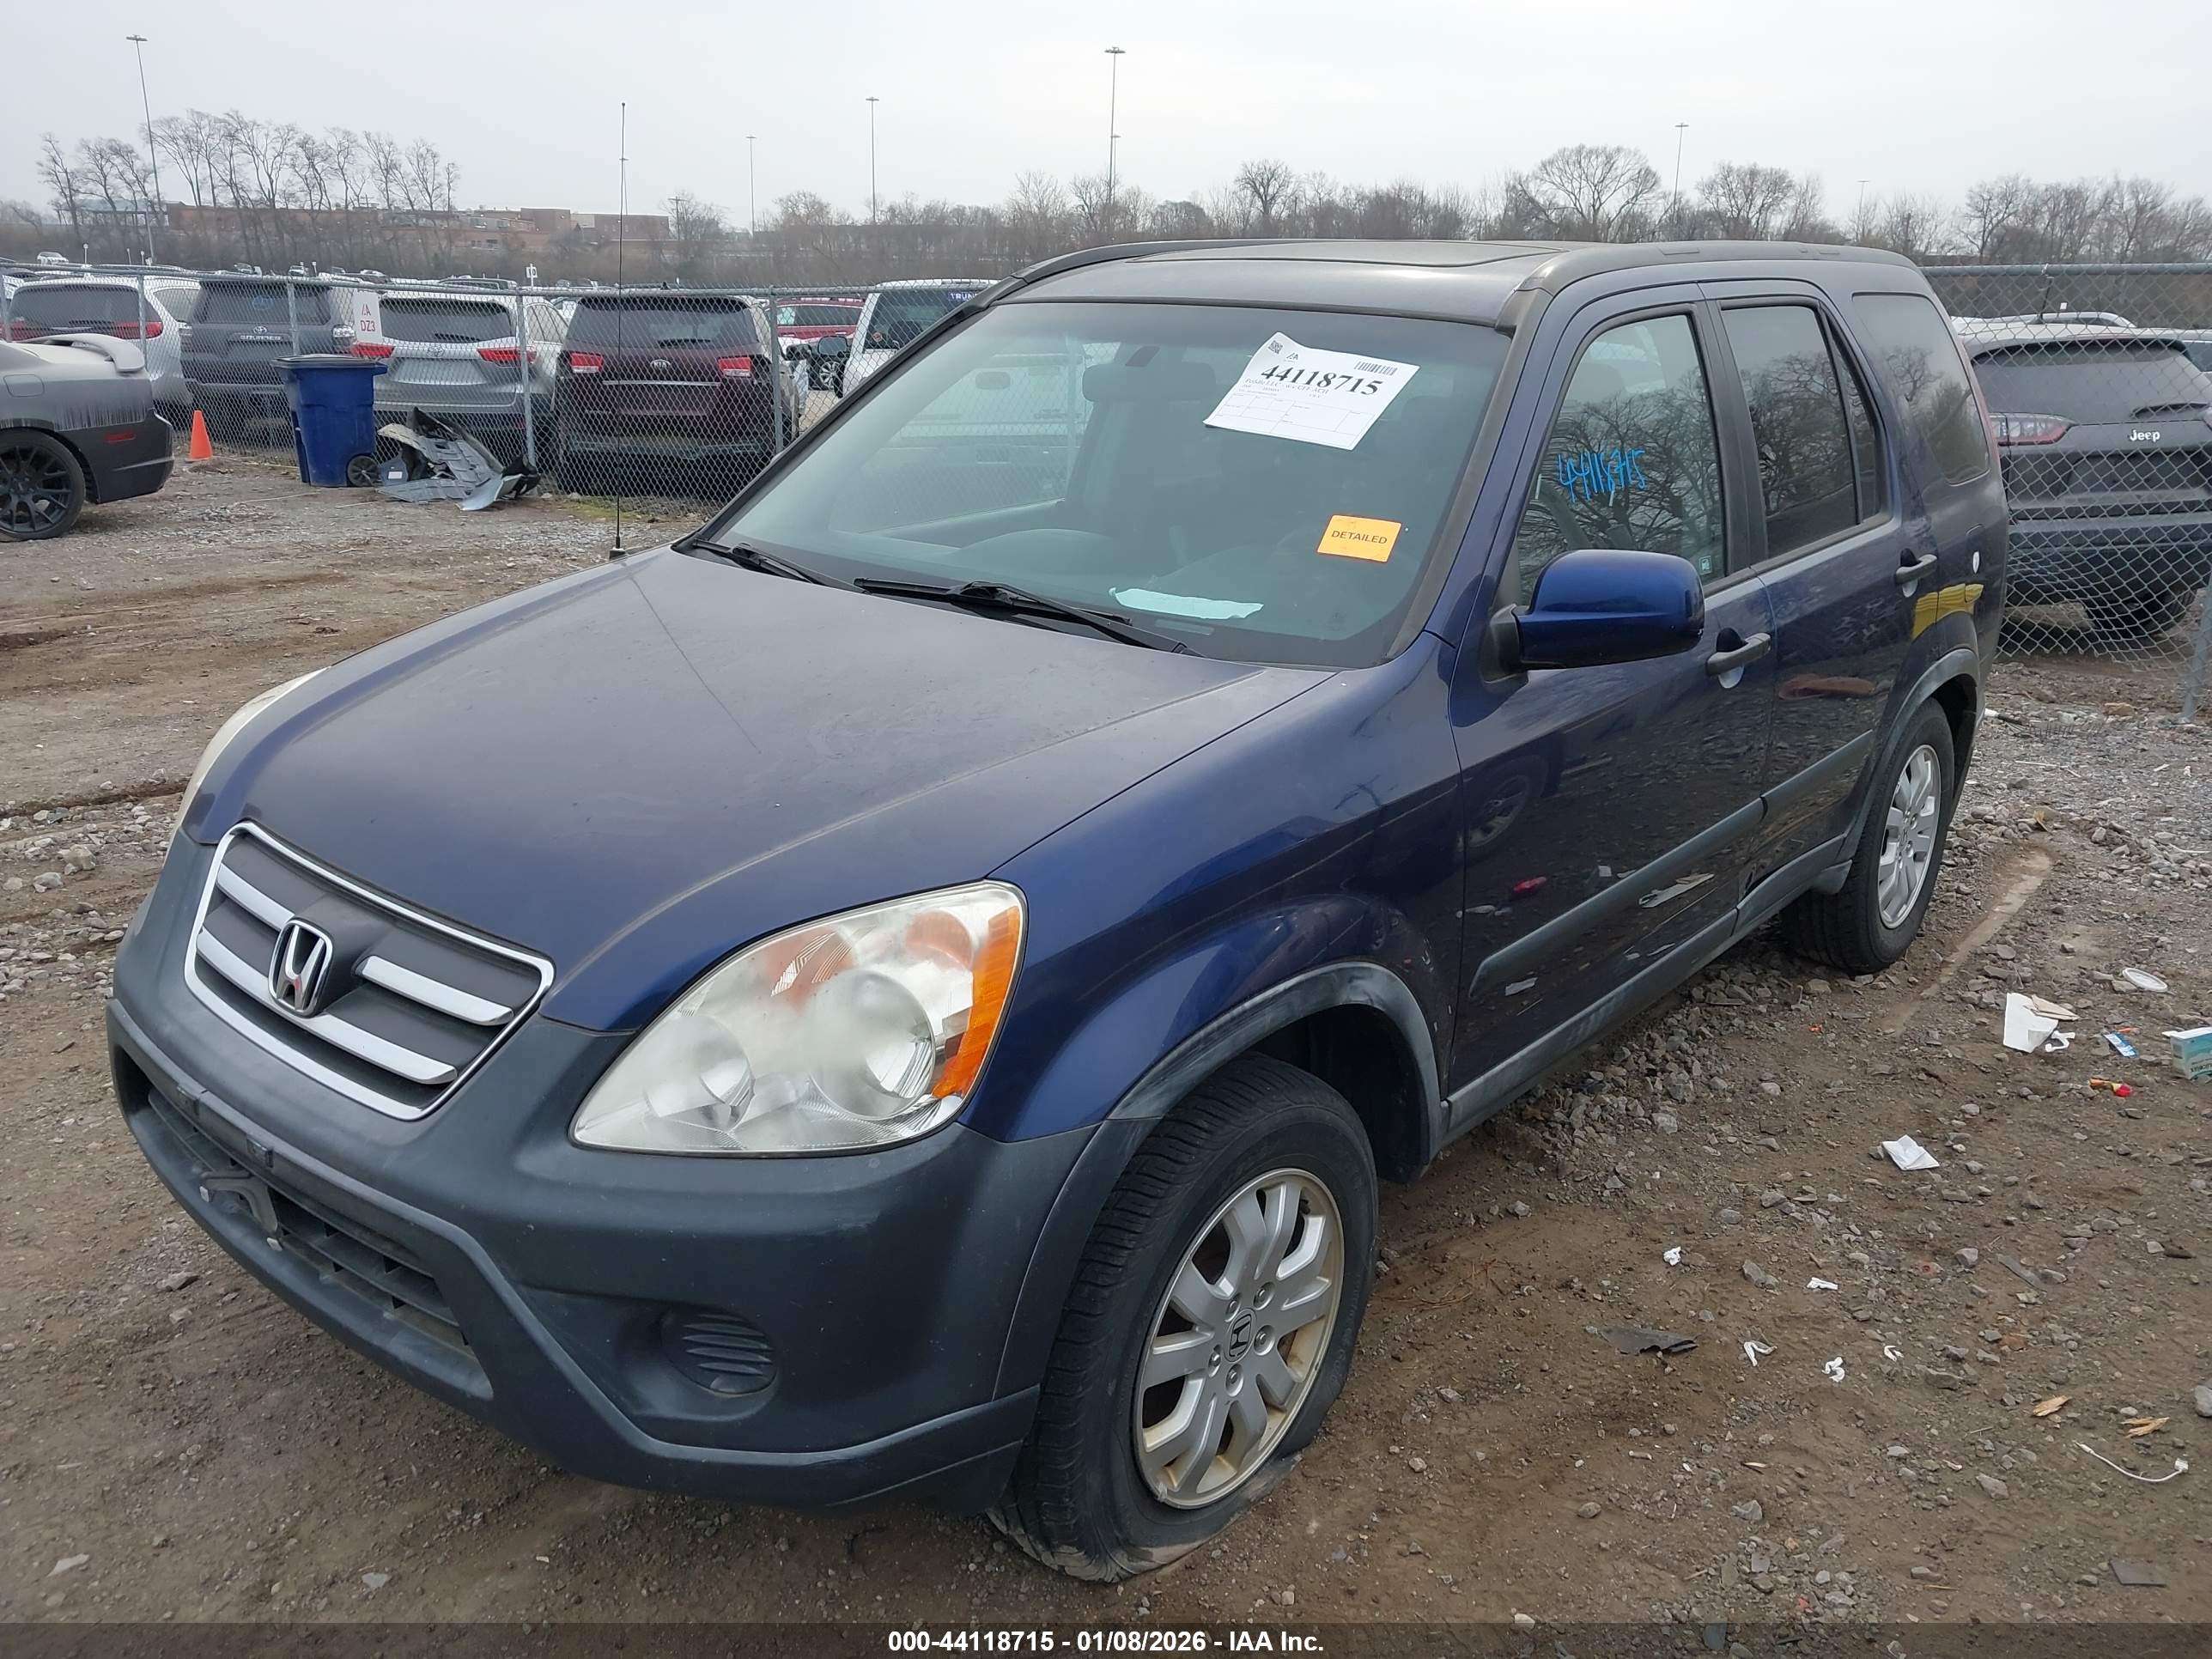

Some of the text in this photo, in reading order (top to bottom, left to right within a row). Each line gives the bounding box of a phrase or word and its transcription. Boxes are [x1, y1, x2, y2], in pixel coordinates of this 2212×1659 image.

[360, 319, 375, 331] DZ3
[1261, 365, 1383, 396] 44118715
[2130, 429, 2160, 443] Jeep
[1331, 530, 1388, 544] DETAILED
